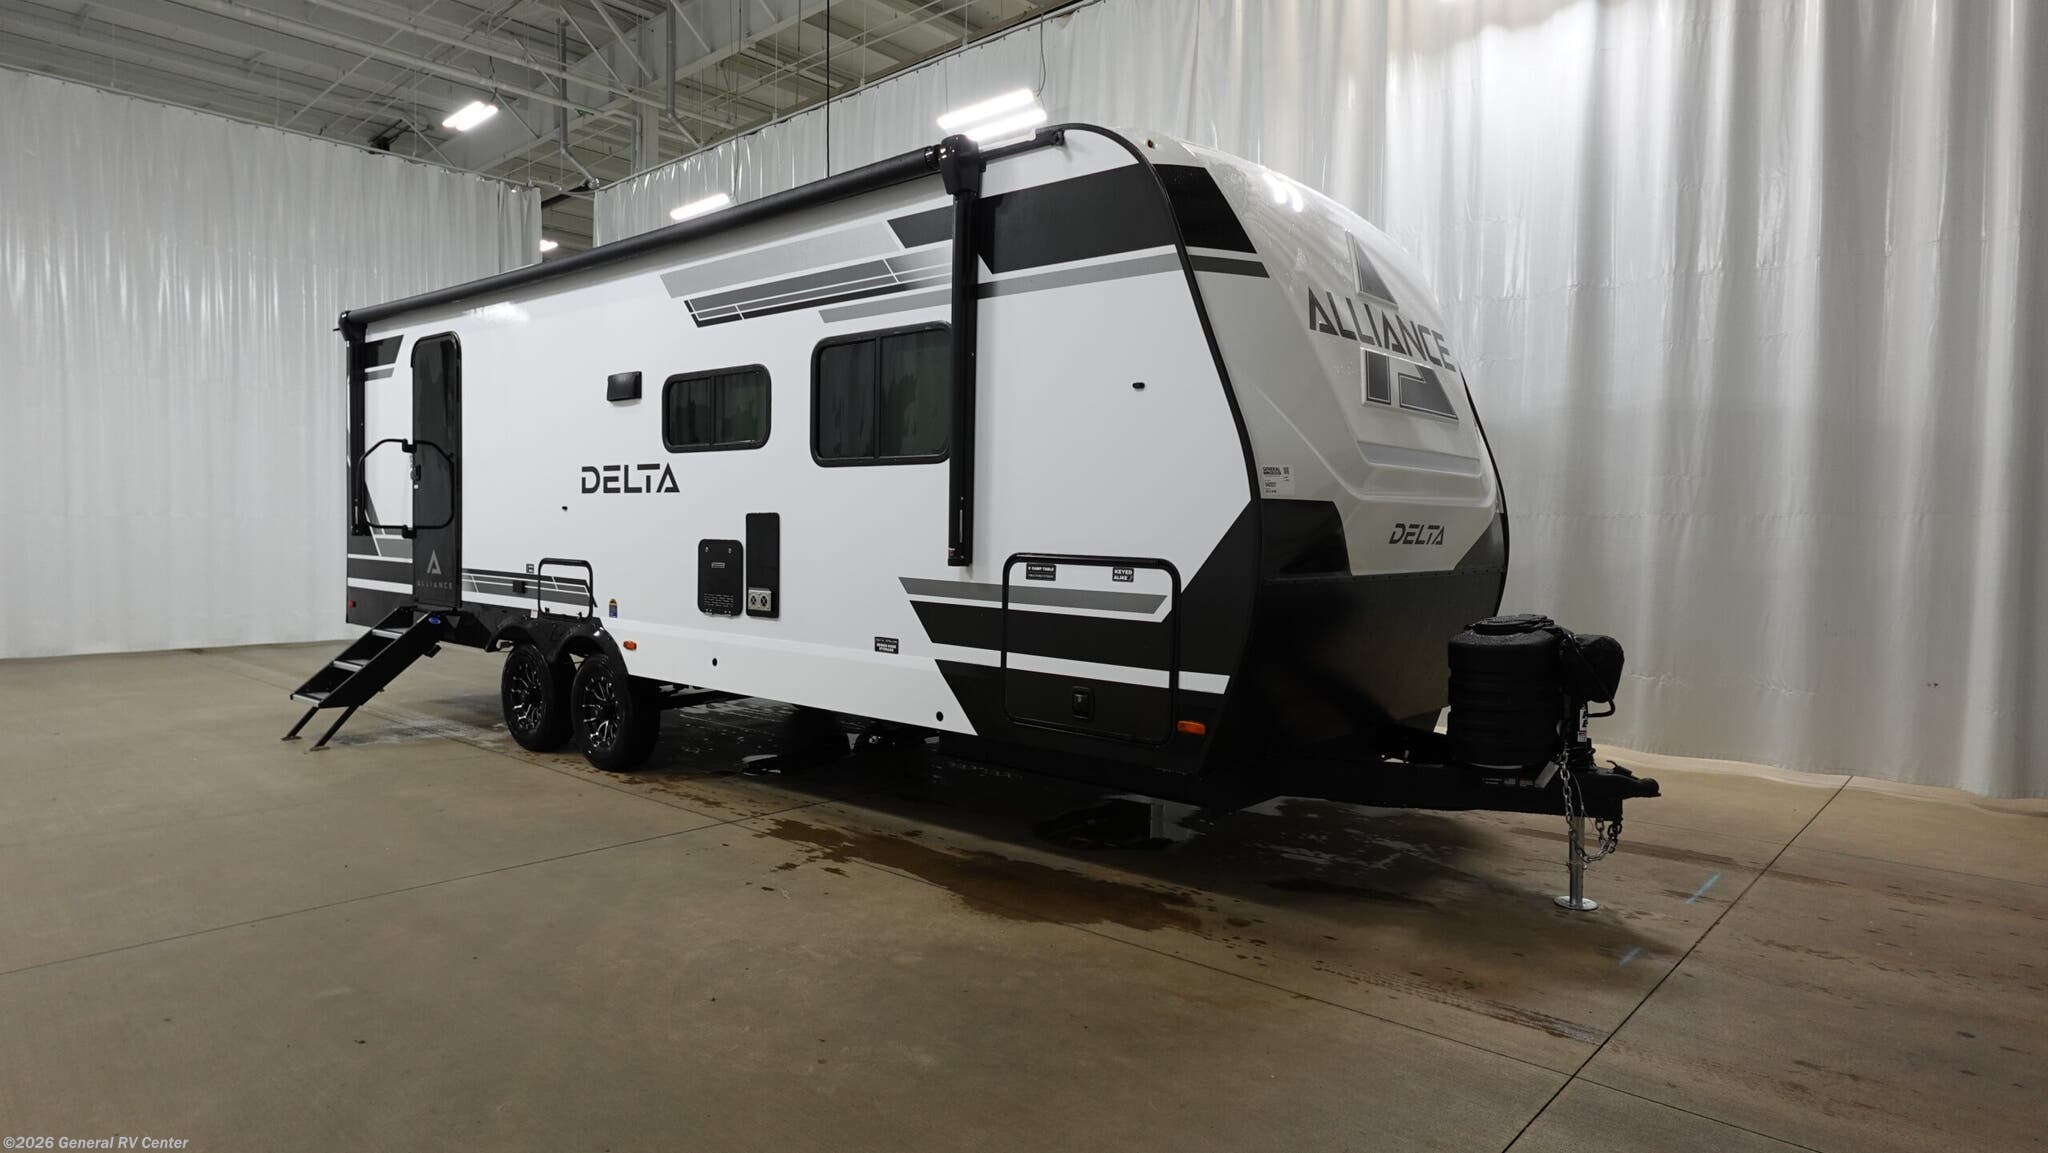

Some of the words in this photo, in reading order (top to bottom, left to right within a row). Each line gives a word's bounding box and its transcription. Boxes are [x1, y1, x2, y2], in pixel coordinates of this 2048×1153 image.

[1308, 286, 1456, 372] ALLIANCE
[581, 462, 680, 494] DELTA
[1389, 523, 1445, 545] DELTA
